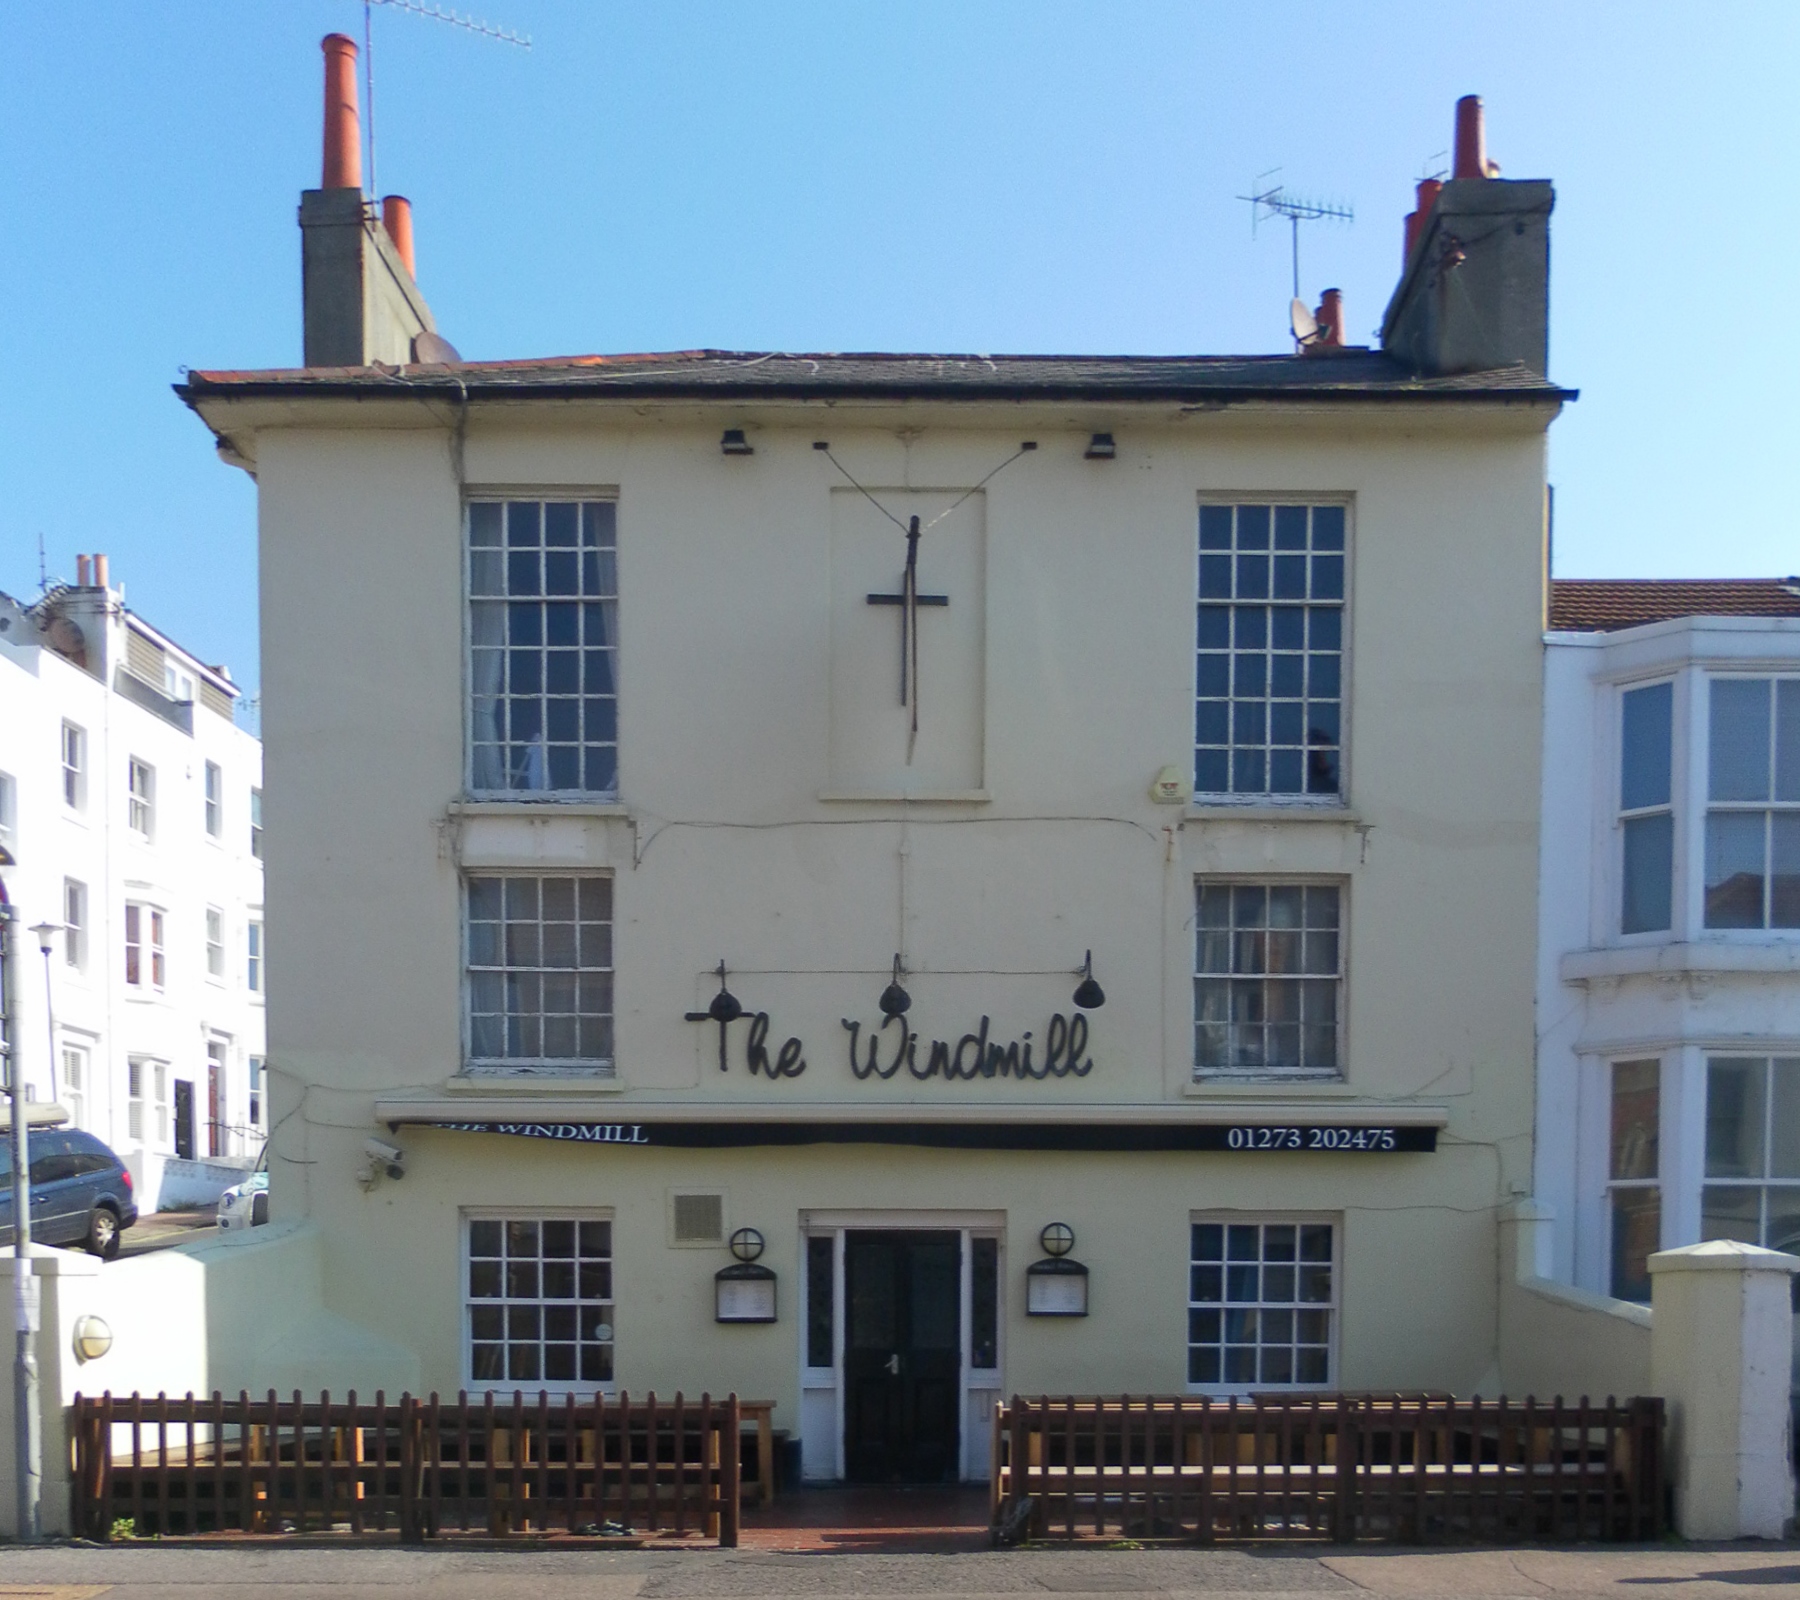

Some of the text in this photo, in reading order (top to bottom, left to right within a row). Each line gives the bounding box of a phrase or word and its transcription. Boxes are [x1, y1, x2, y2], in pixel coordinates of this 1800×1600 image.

[684, 1011, 1093, 1081] The Windmill
[498, 1124, 649, 1143] WINDMILL
[1228, 1128, 1395, 1149] 01273 202475
